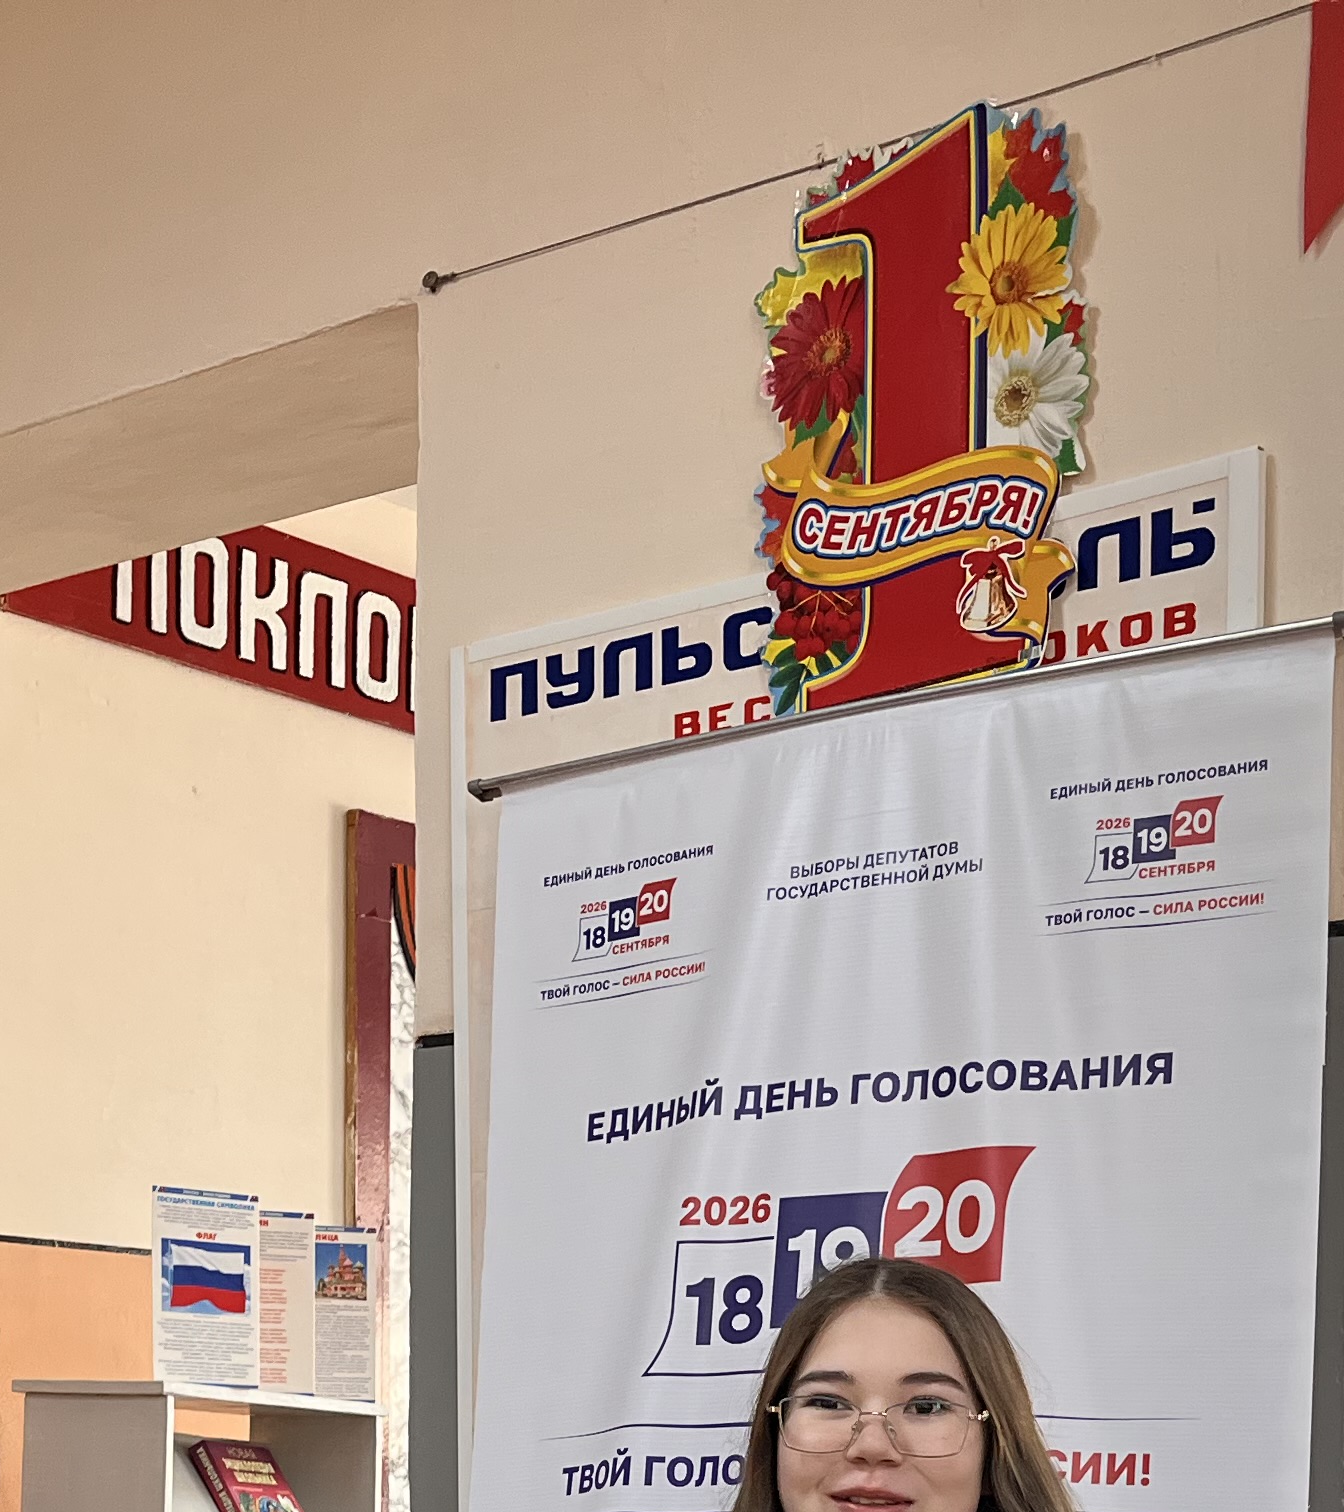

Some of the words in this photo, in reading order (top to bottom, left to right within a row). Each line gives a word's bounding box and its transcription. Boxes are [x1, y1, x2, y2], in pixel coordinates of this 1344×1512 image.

[797, 483, 1036, 551] СЕНТЯБРЯ!
[116, 537, 416, 711] ПОКЛО
[490, 606, 773, 722] ПУЛЬС
[674, 695, 771, 739] ВЕС
[1042, 602, 1197, 665] ОКОВ
[1050, 778, 1112, 800] ЕДИНЫЙ
[1114, 776, 1154, 793] ДЕНЬ
[1158, 759, 1269, 786] ГОЛОСОВАНИЯ
[1096, 817, 1131, 831] 2026
[1099, 845, 1130, 871] 18
[1137, 826, 1168, 855] 19
[1174, 808, 1213, 838] 20
[543, 867, 592, 887] ЕДИНЫЙ
[594, 863, 625, 879] ДЕНЬ
[627, 845, 714, 871] ГОЛОСОВАНИЯ
[766, 865, 929, 900] ГОСУДАРСТВЕННОЙ
[932, 857, 984, 882] ДУМЫ
[790, 856, 859, 879] ВЫБОРЫ
[863, 841, 959, 870] ДЕПУТАТОВ
[1138, 860, 1216, 880] СЕНТЯБРЯ
[580, 901, 607, 914] 2026
[582, 926, 606, 950] 18
[611, 907, 634, 933] 19
[639, 889, 669, 917] 20
[1045, 908, 1083, 927] ТВОЙ
[1086, 906, 1136, 922] ГОЛОС
[1153, 900, 1194, 916] СИЛА
[1198, 892, 1265, 912] РОССИИ!
[612, 934, 670, 955] СЕНТЯБРЯ
[540, 984, 570, 1001] ТВОЙ
[573, 979, 611, 996] ГОЛОС
[622, 971, 652, 987] СИЛА
[655, 961, 706, 980] РОССИИ!
[586, 1077, 723, 1144] ЕДИНЫЙ
[733, 1077, 839, 1121] ДЕНЬ
[850, 1051, 1175, 1105] ГОЛОСОВАНИЯ
[678, 1192, 772, 1228] 2026
[315, 1233, 339, 1242] ЛИЦА
[685, 1273, 764, 1347] 18
[894, 1179, 997, 1259] 20
[562, 1447, 632, 1496] ТВОЙ
[644, 1454, 747, 1488] ГОЛО
